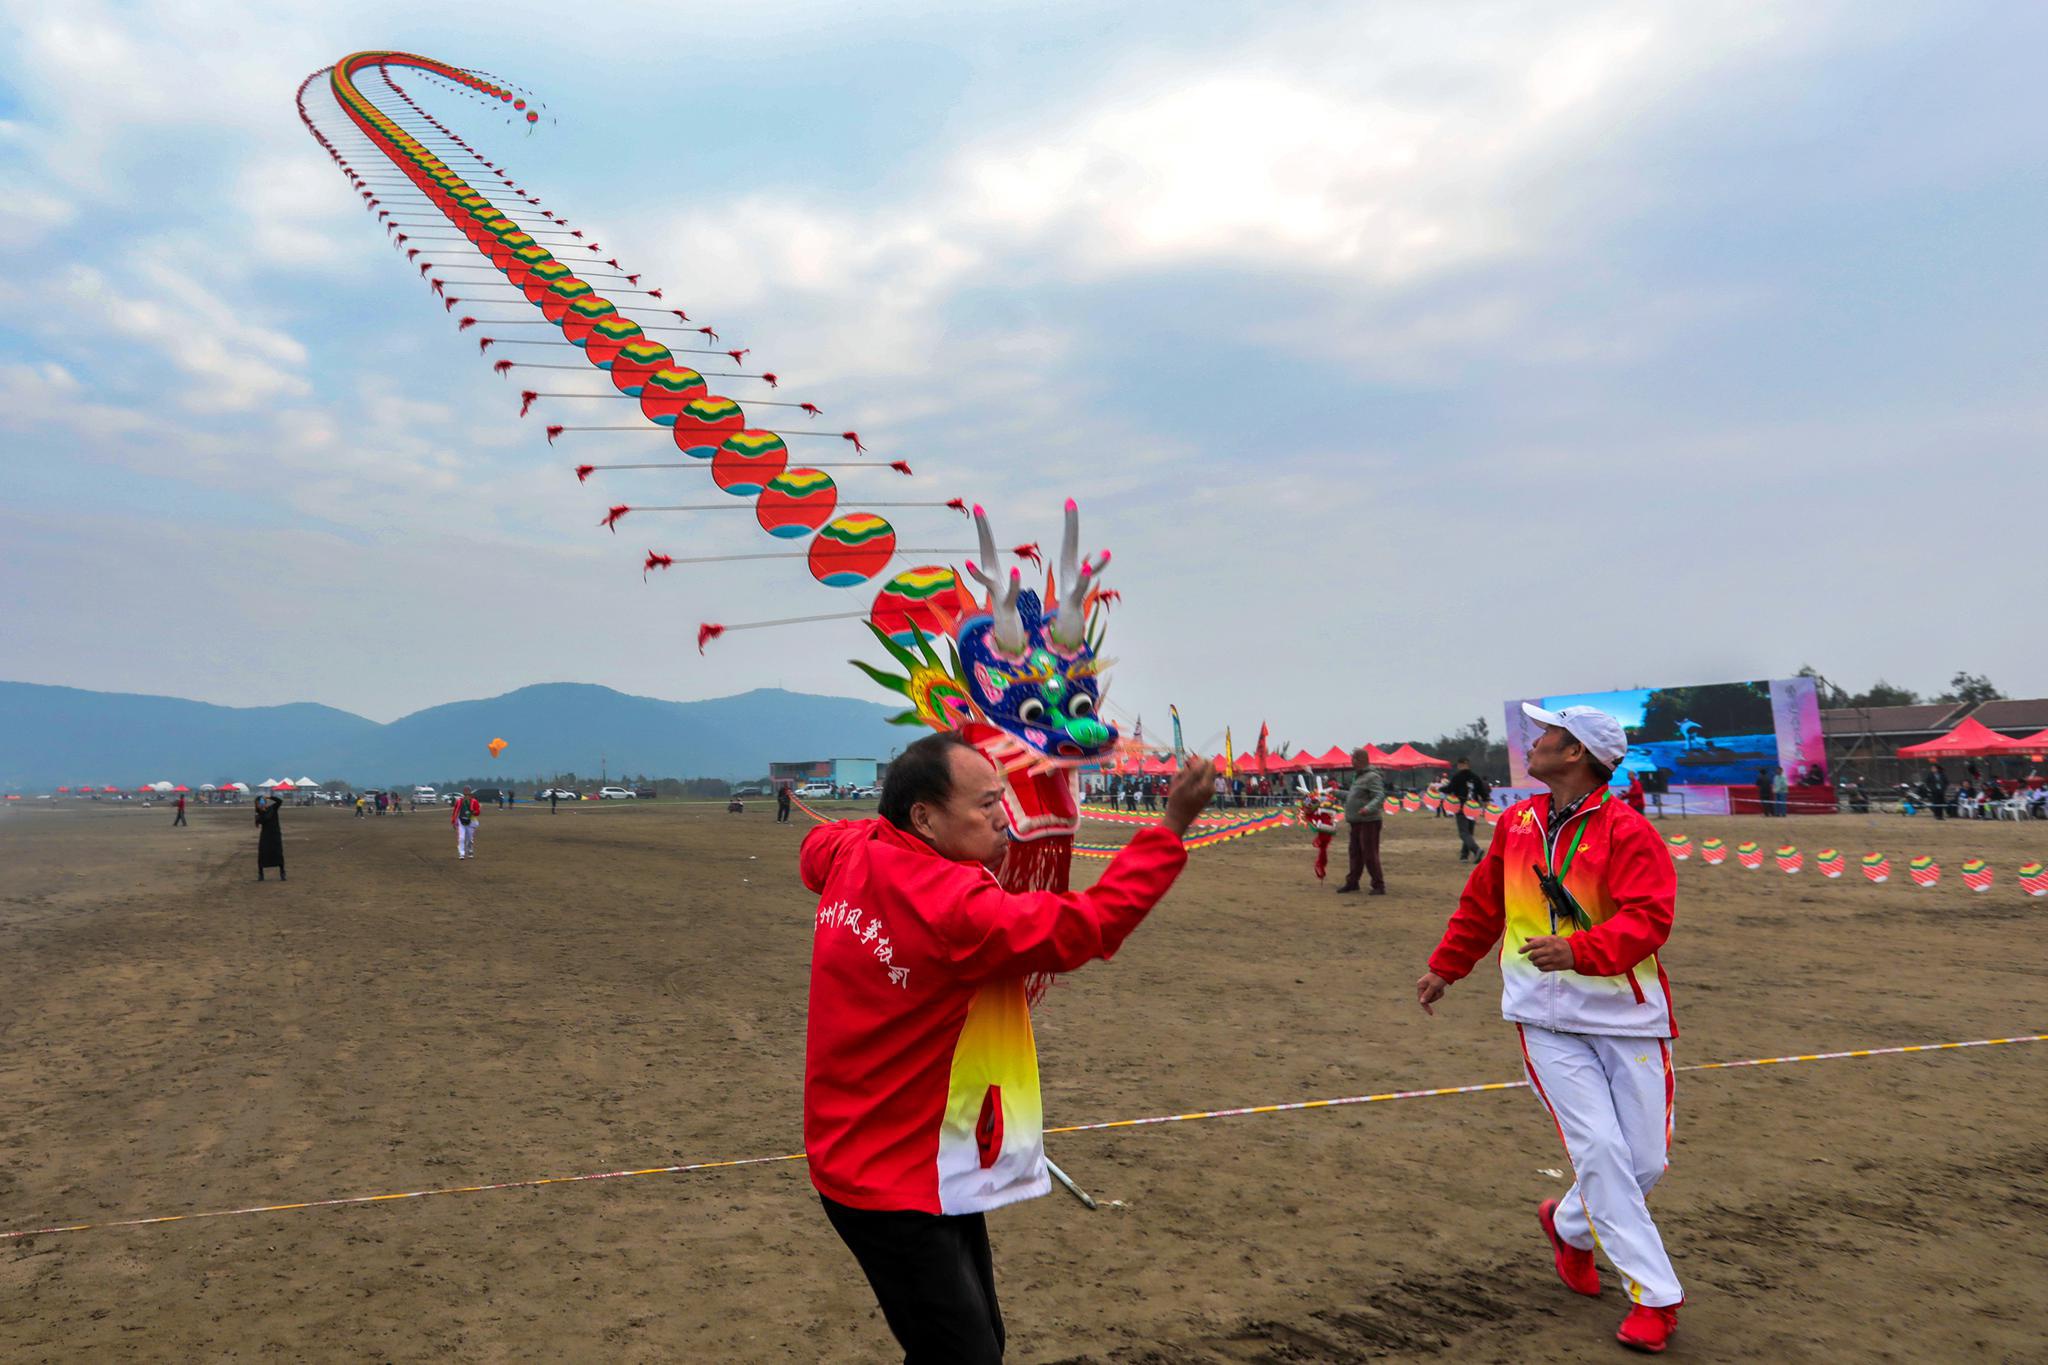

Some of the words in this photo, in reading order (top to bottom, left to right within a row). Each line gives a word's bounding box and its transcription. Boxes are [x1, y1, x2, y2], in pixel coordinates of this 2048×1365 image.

[815, 899, 910, 989] 州市风筝协会
